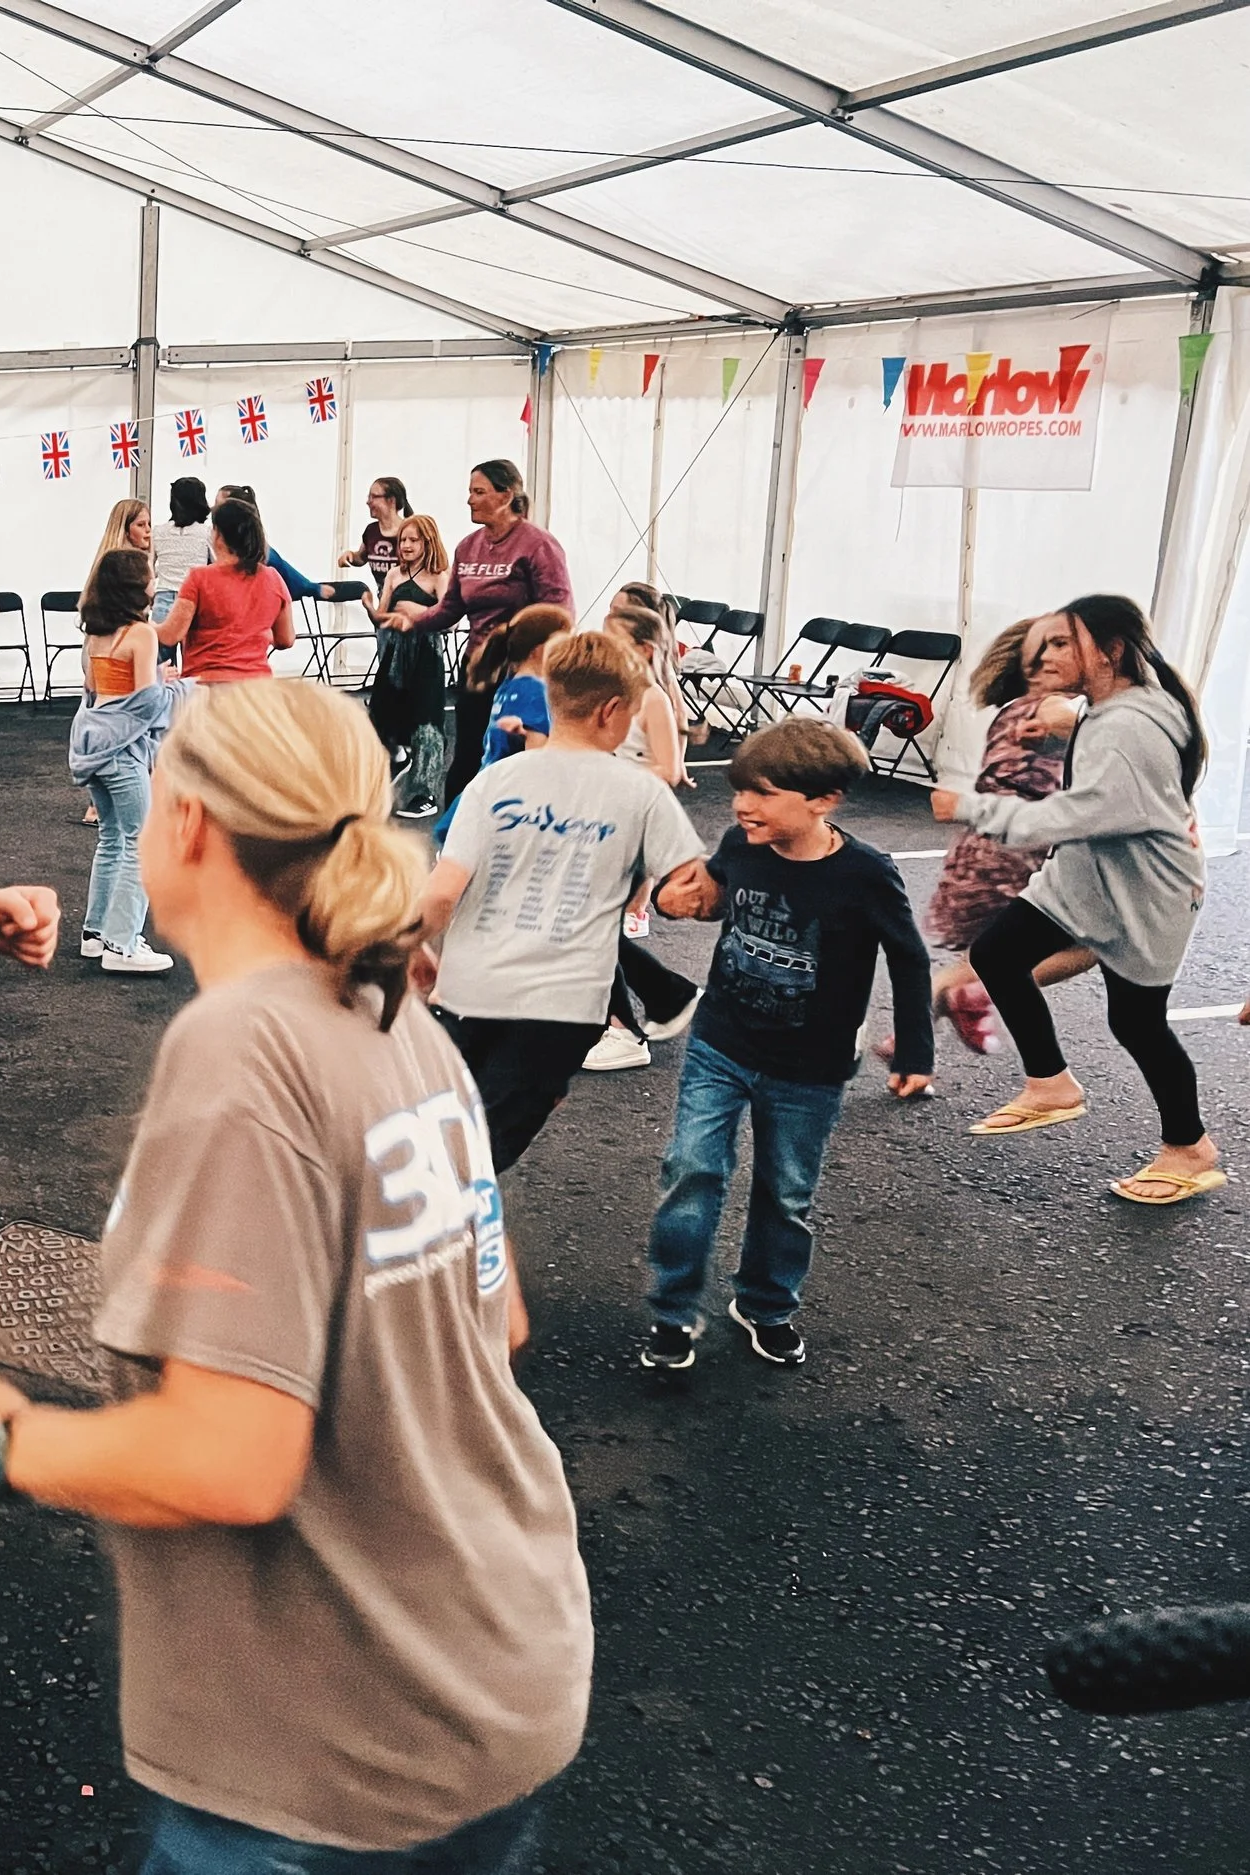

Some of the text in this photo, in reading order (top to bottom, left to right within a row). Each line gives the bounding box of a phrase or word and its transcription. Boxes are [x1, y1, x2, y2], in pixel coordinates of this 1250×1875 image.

[908, 358, 1091, 416] Marlow
[477, 564, 512, 576] FLIES
[735, 888, 769, 906] OUT
[748, 914, 798, 942] WILD
